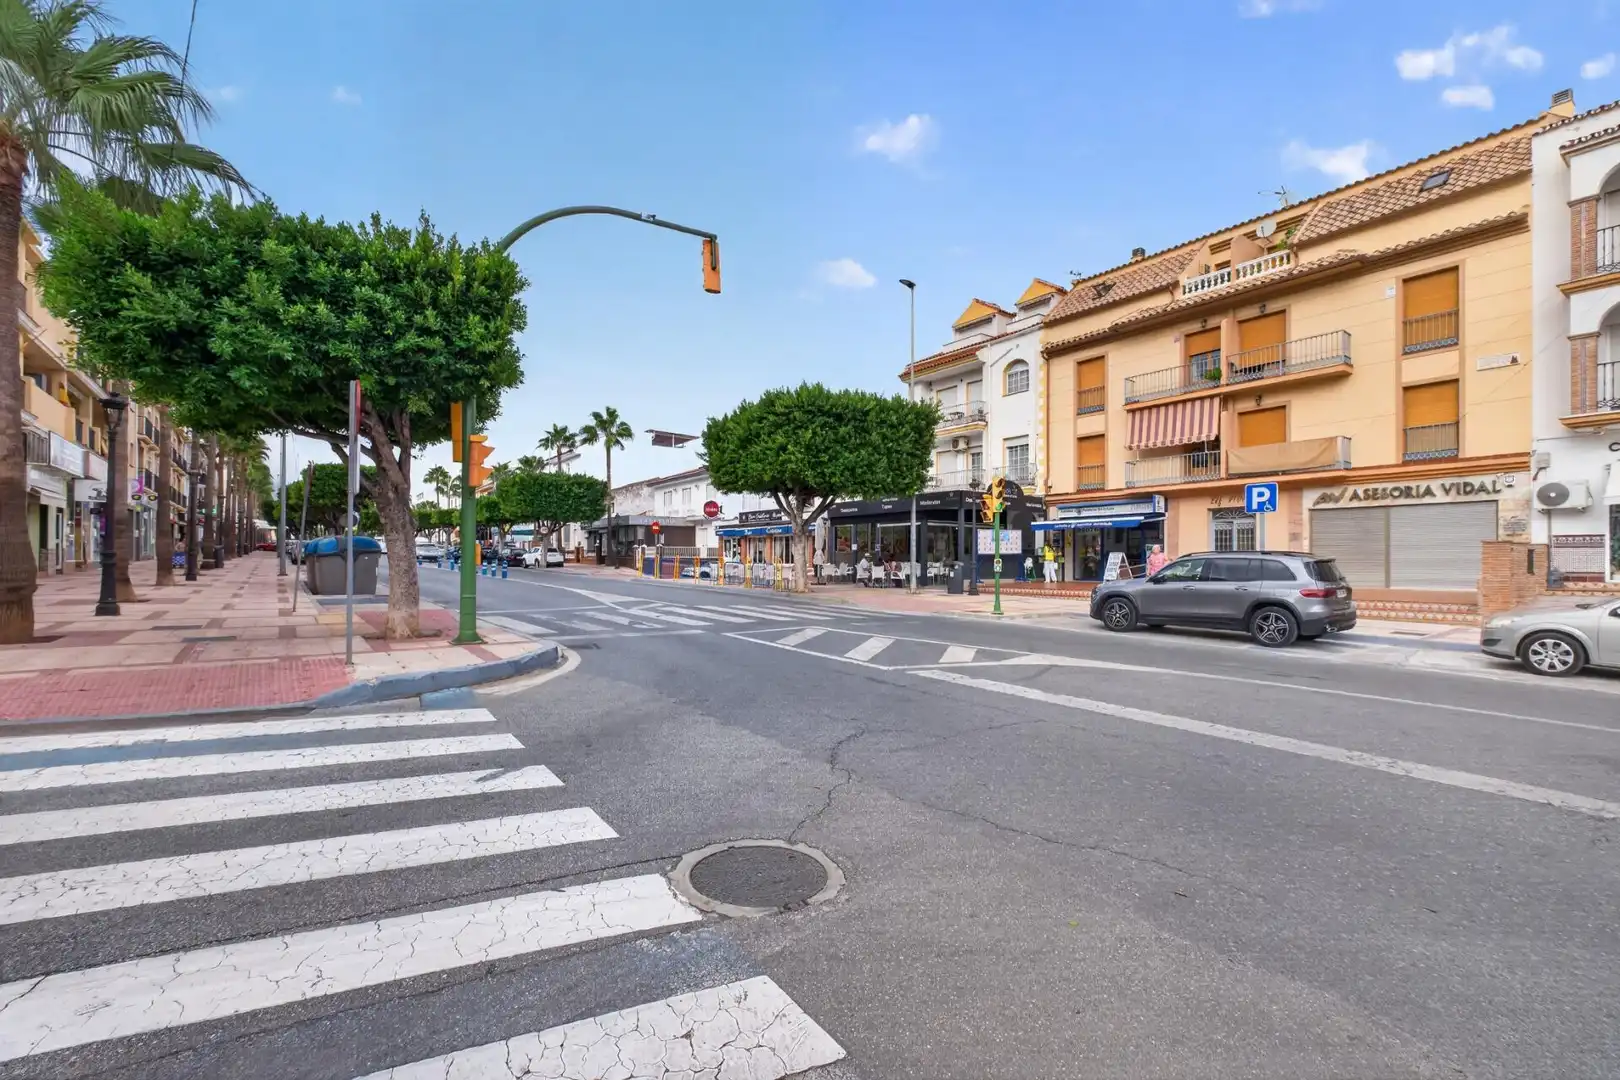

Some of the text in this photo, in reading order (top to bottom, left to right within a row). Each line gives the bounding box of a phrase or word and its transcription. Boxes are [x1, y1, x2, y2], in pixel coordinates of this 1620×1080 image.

[1251, 487, 1271, 510] P
[1348, 484, 1437, 502] ASESORIA
[1440, 479, 1502, 497] VIDAL
